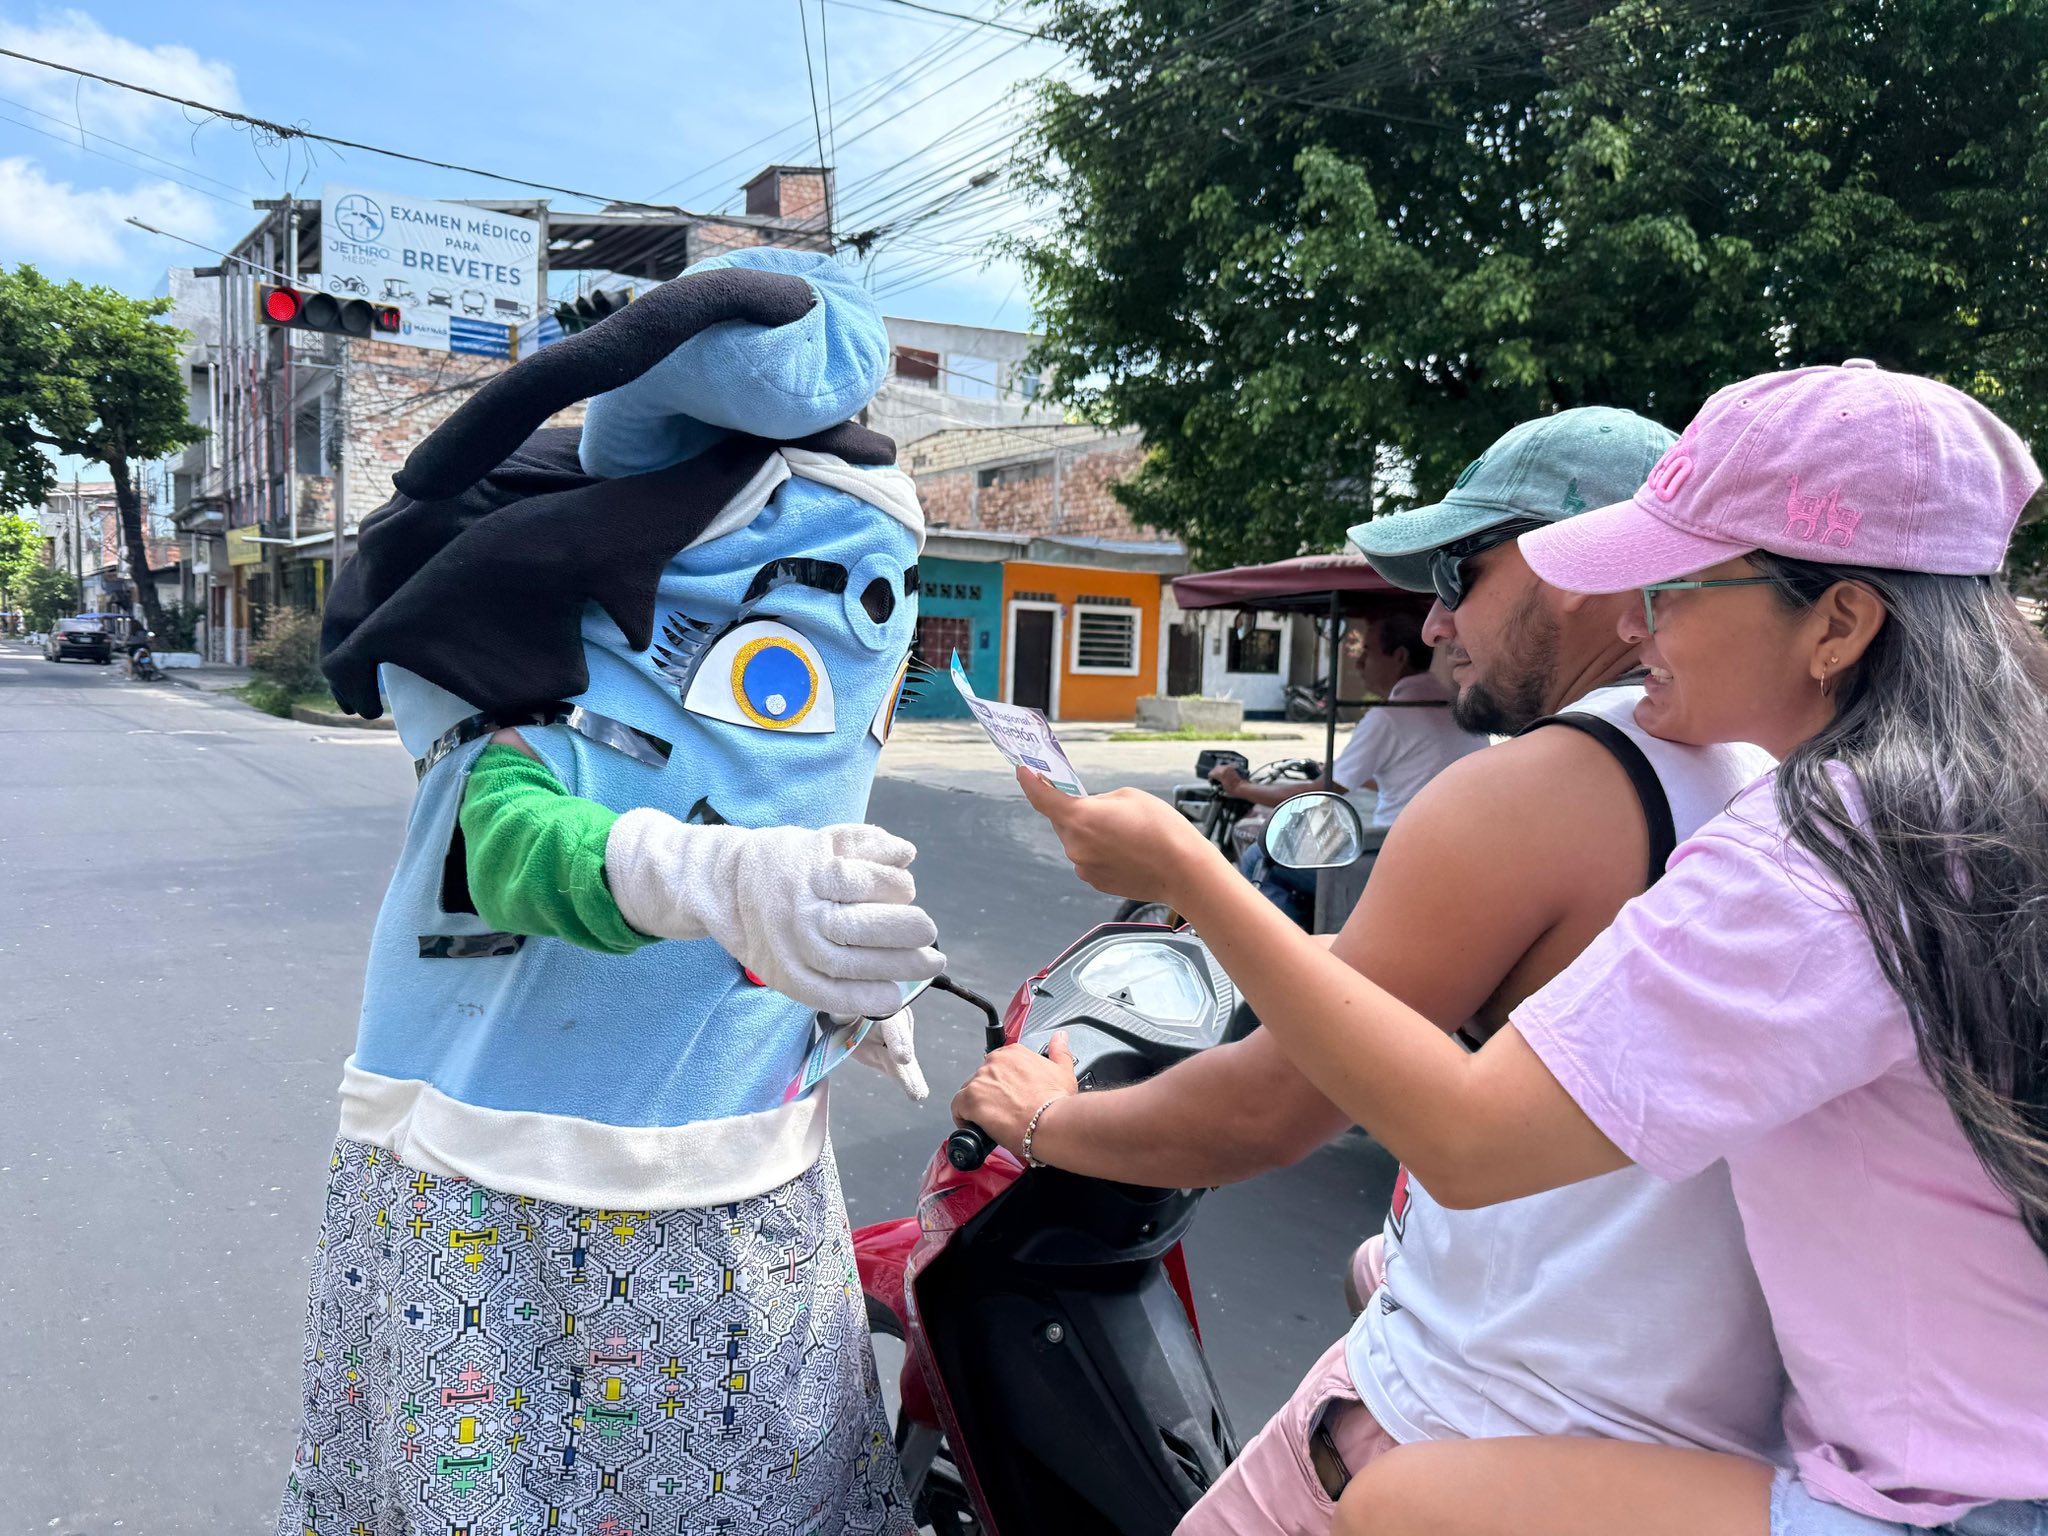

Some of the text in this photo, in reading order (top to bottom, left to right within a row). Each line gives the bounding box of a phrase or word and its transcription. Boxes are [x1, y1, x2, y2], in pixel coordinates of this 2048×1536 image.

[391, 206, 531, 243] EXAMEN MÉDICO
[329, 241, 390, 259] JETHRO
[445, 238, 480, 253] PARA
[403, 249, 521, 285] BREVETES
